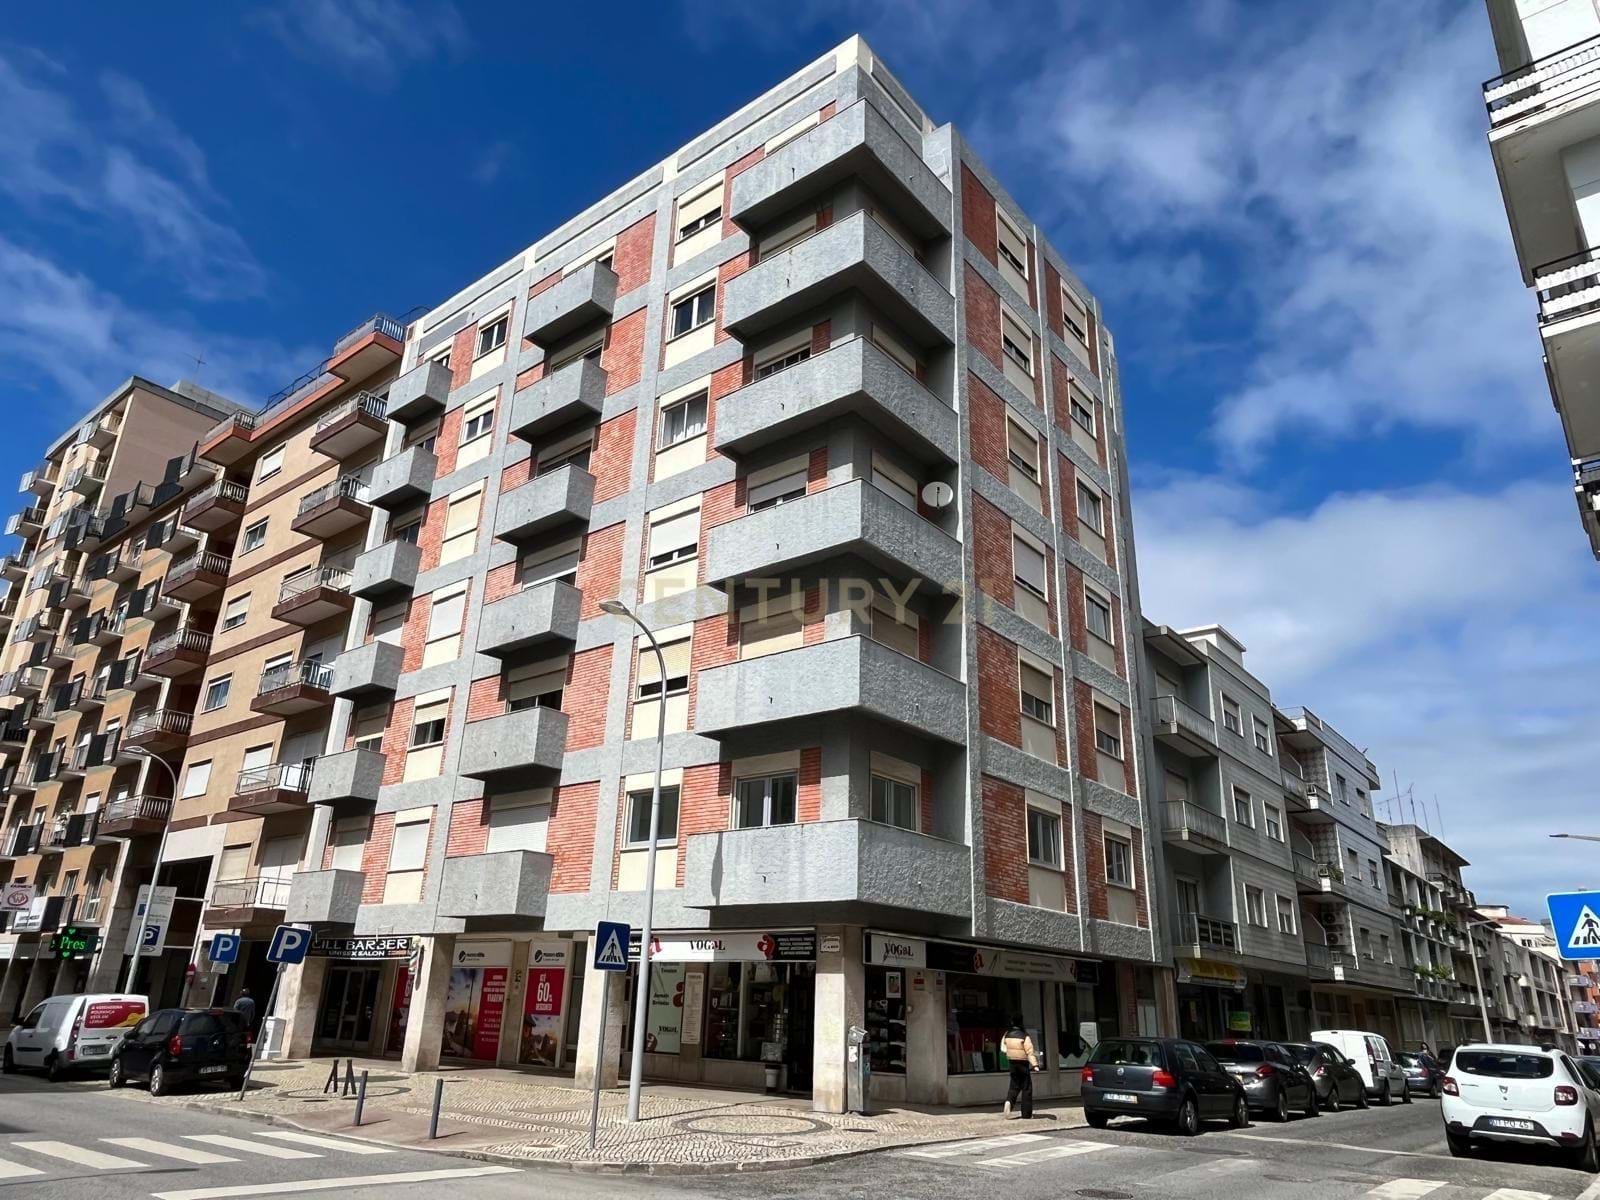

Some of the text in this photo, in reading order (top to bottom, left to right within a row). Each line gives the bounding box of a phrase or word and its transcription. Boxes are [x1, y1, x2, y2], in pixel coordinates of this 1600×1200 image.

[60, 936, 86, 950] Pres
[215, 937, 234, 959] P
[275, 930, 302, 959] P
[346, 938, 407, 951] BARBER
